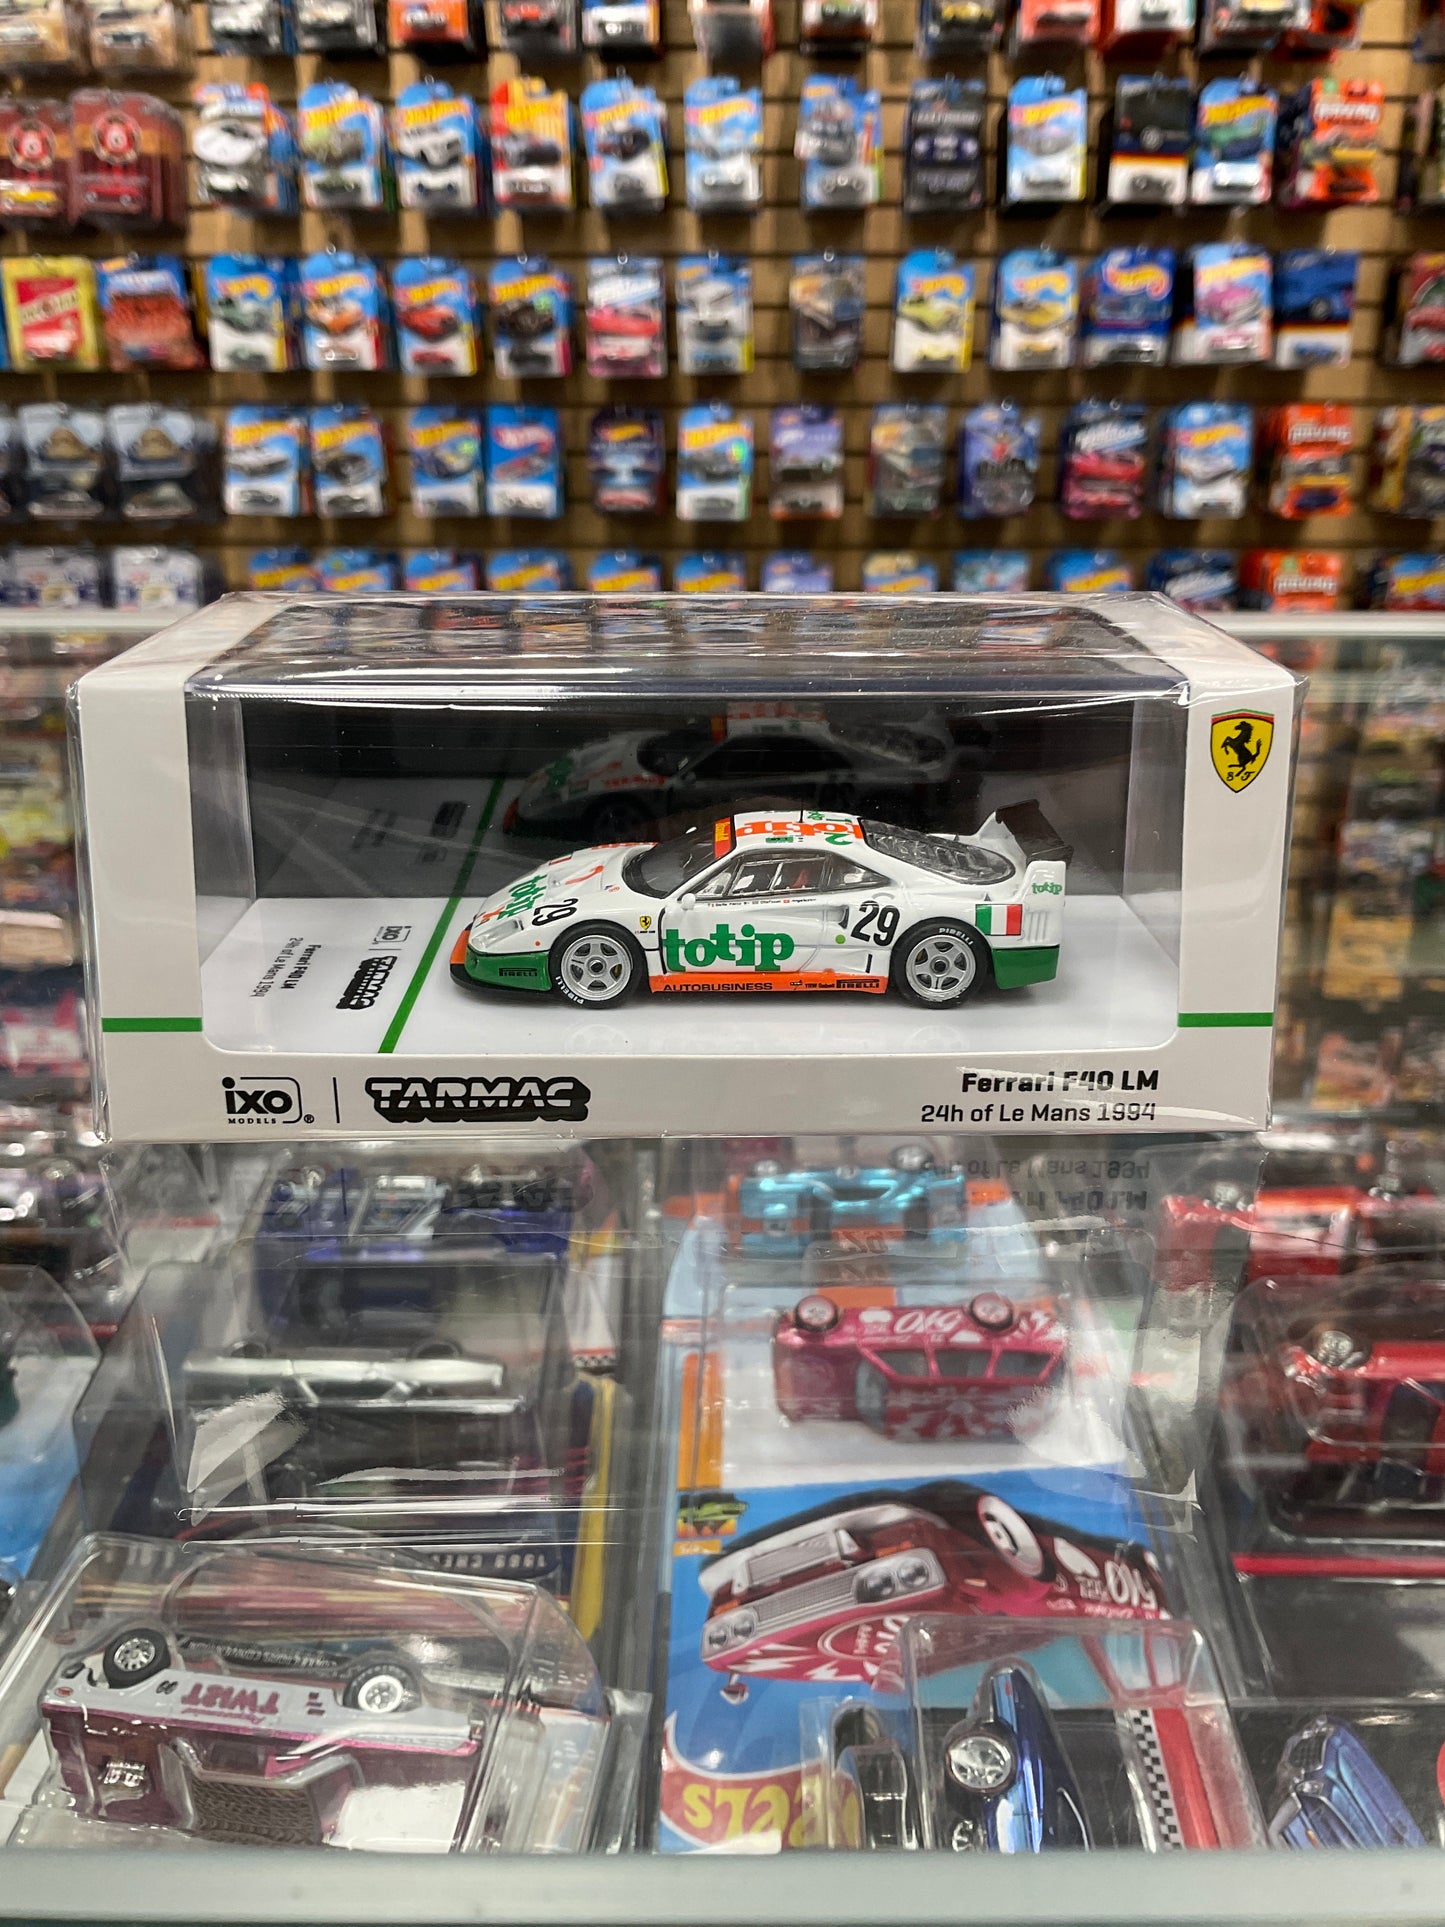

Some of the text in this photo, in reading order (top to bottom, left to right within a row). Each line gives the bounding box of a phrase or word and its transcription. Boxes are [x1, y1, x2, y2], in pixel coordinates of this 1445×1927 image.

[1031, 882, 1063, 895] totip
[531, 898, 579, 927] 29
[850, 900, 900, 947] 29
[938, 927, 974, 946] PIRELLI
[297, 944, 322, 967] Ferrari
[662, 924, 795, 972] totip
[262, 963, 286, 980] Mans
[288, 966, 308, 979] F40
[498, 967, 538, 977] PIRELLI
[250, 980, 275, 998] 1994
[663, 982, 773, 992] AUTOBUSINESS
[836, 979, 880, 989] PIRELLI
[961, 1070, 1159, 1093] Ferrari F40 LM
[222, 1077, 294, 1115] ixo
[365, 1077, 590, 1121] TARMAC
[921, 1103, 1156, 1123] 24h of Le Mans 1994
[180, 1683, 280, 1715] TWIST
